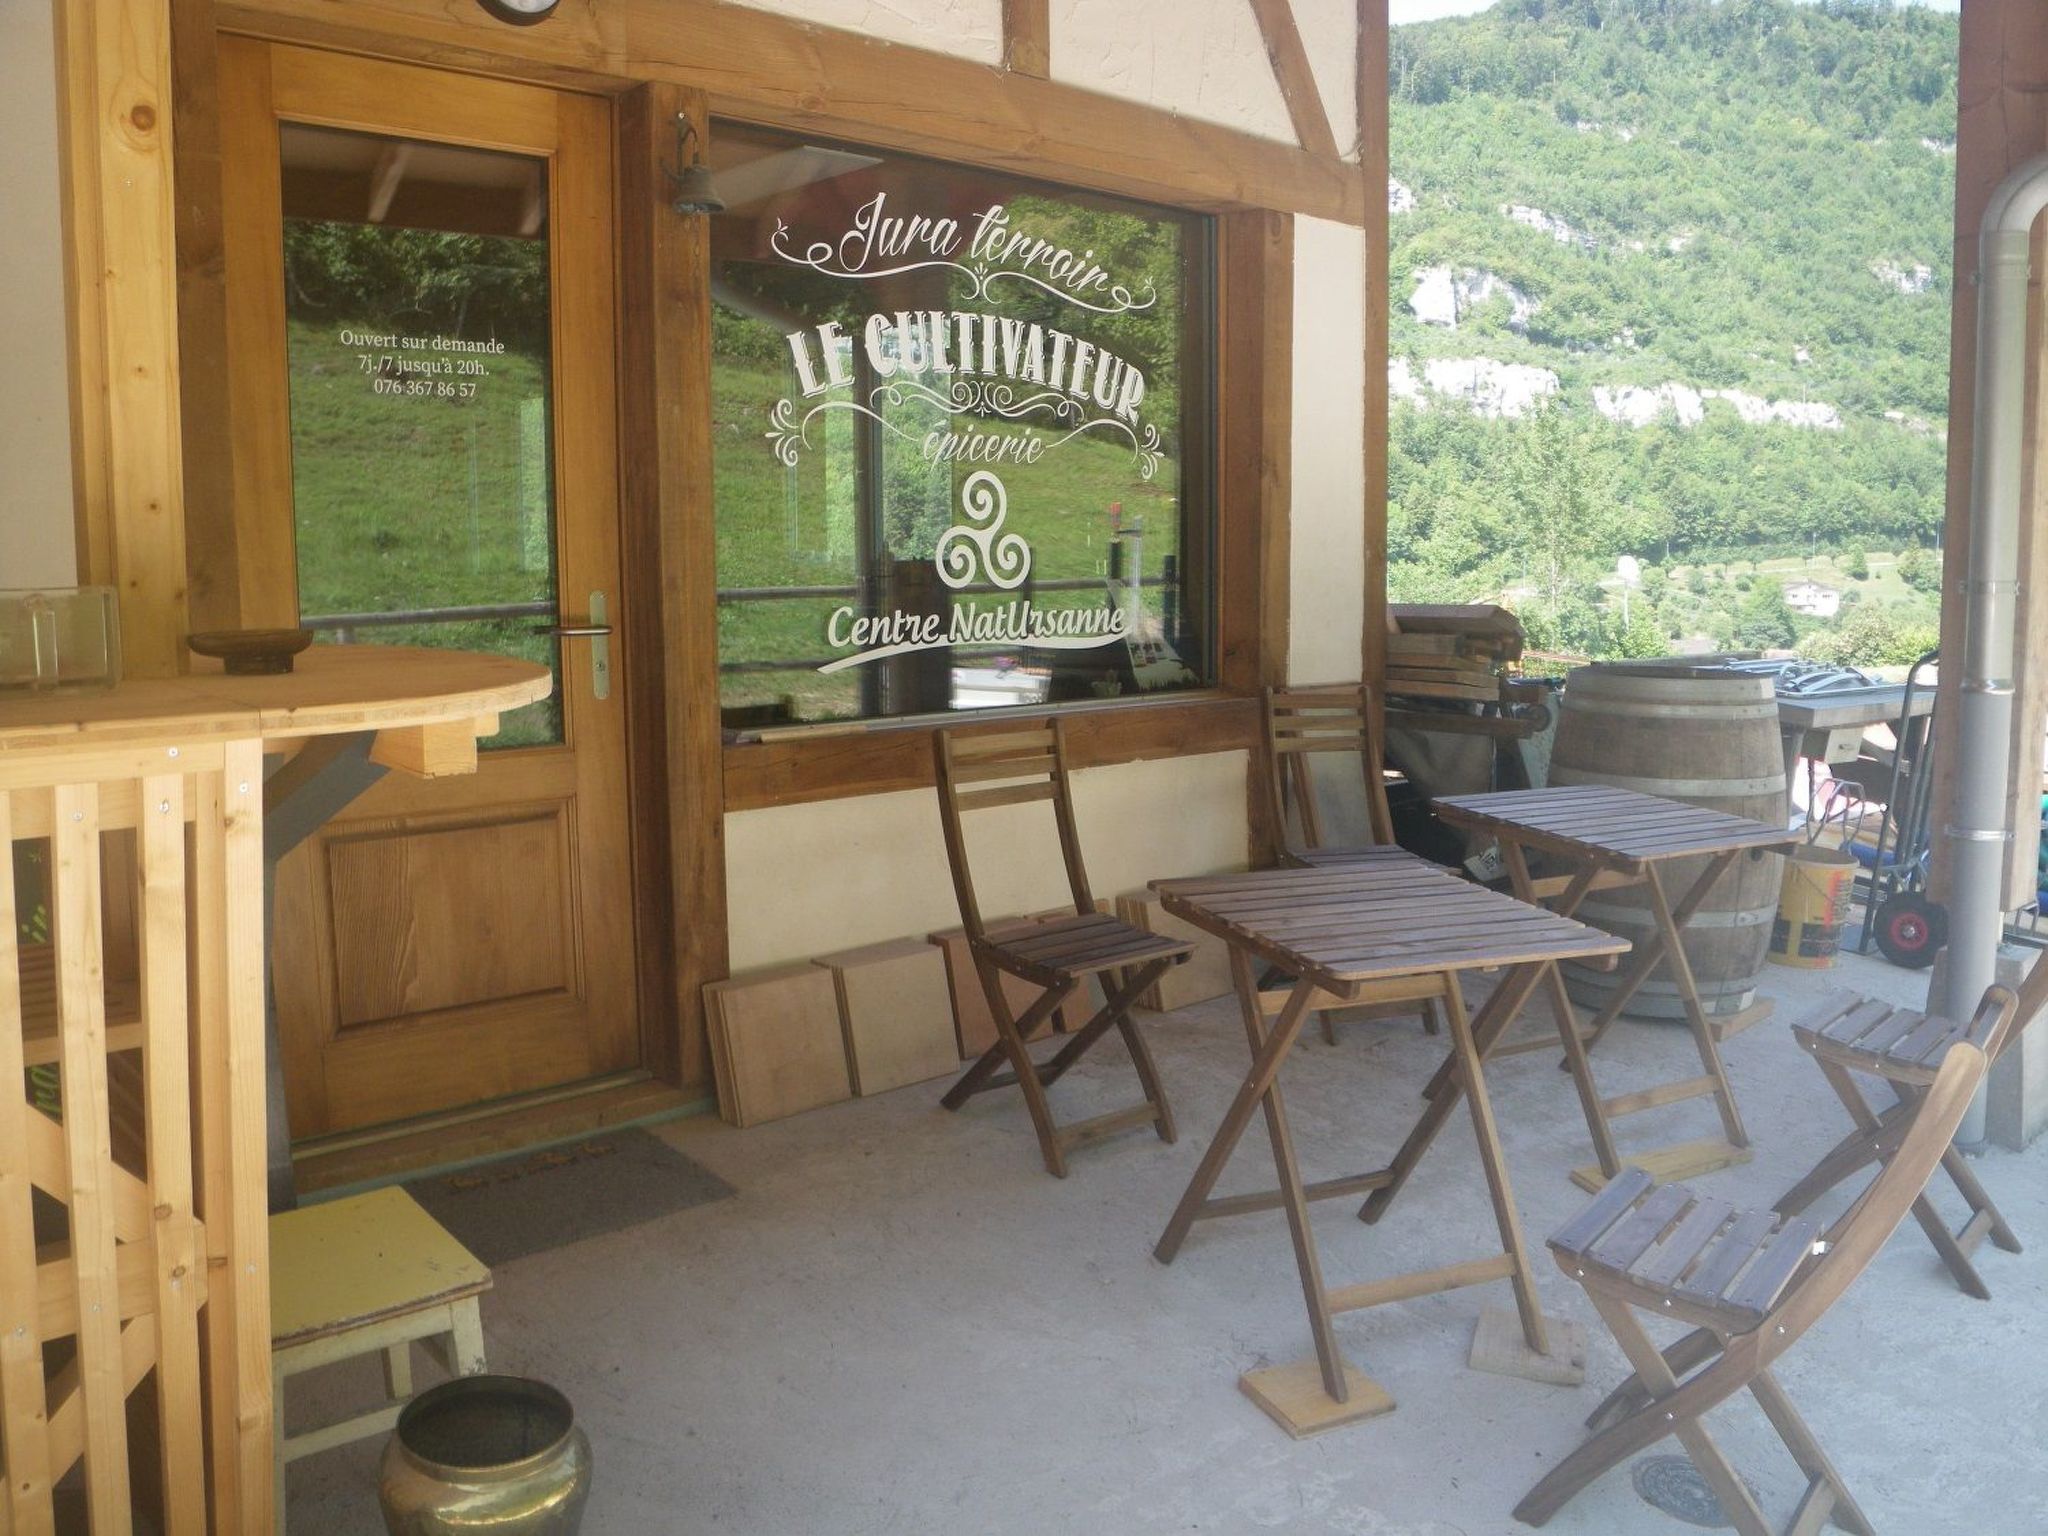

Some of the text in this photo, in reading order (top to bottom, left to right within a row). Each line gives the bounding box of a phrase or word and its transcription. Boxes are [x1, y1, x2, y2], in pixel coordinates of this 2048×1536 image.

[839, 191, 1108, 293] Jura terroir
[340, 329, 505, 354] Ouvert sur demande
[357, 354, 490, 377] 7j./7 jusqu'à 20h.
[374, 379, 476, 398] 076 367 86 57
[786, 310, 1145, 427] LE CULTIVATEUR
[923, 419, 1046, 473] épicerie
[827, 600, 1126, 648] Centre NatUrsanne
